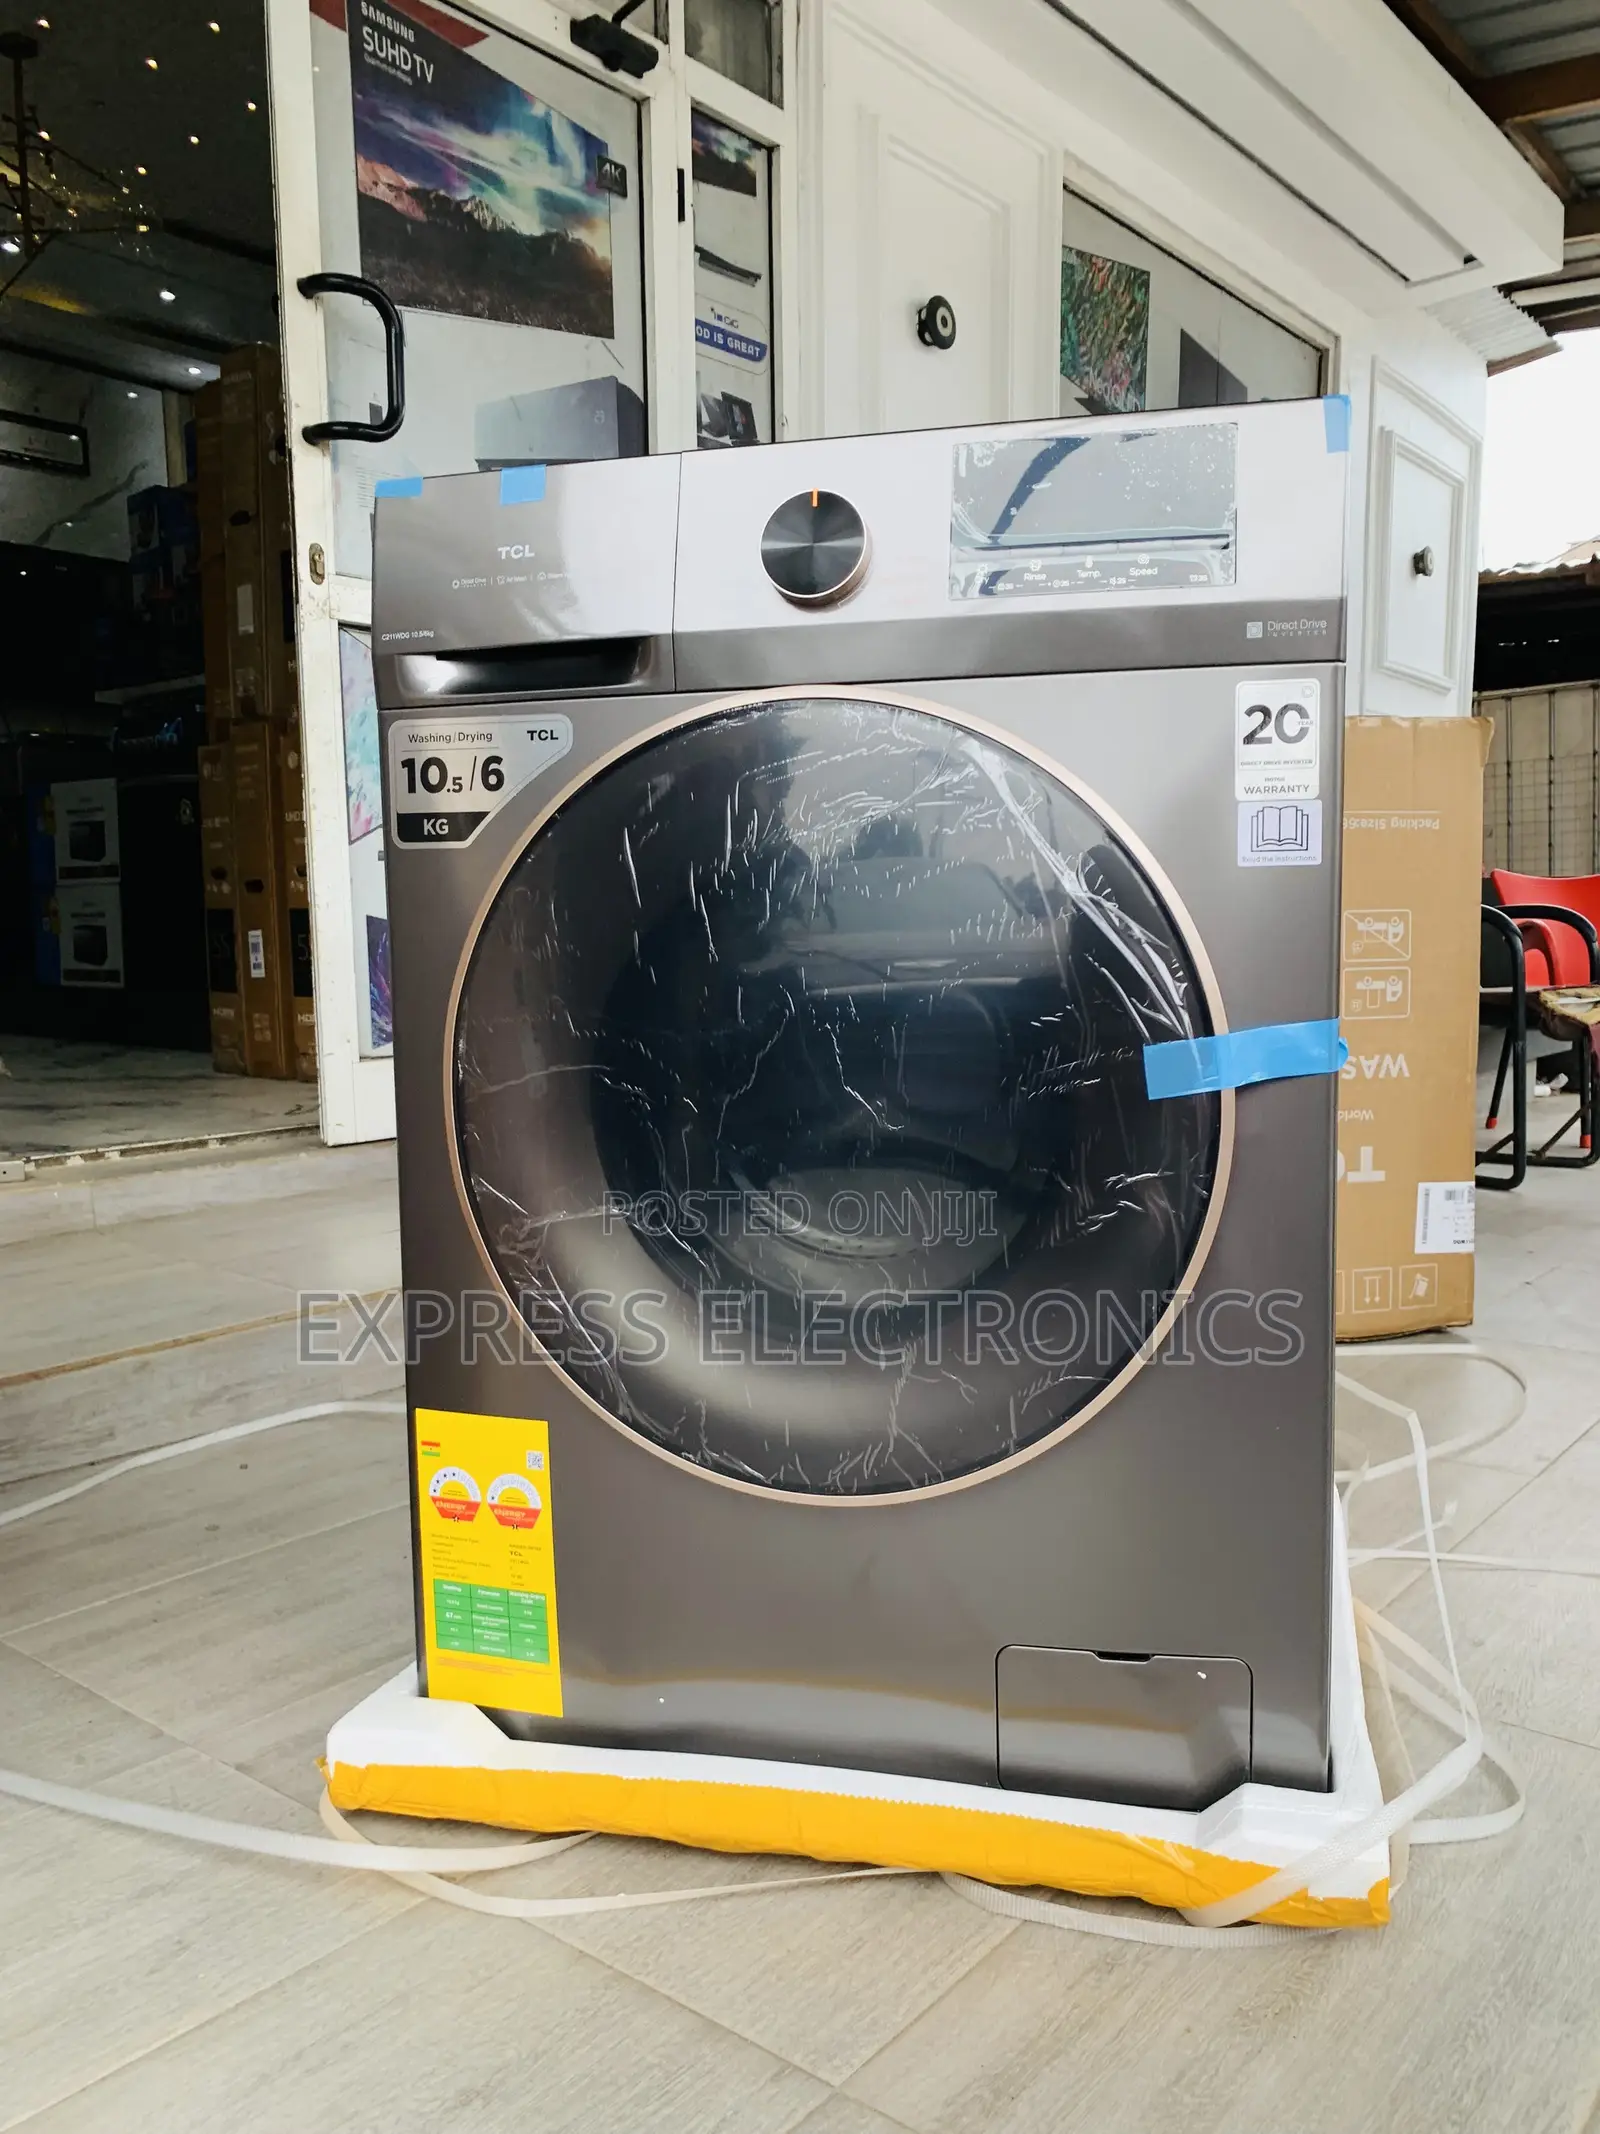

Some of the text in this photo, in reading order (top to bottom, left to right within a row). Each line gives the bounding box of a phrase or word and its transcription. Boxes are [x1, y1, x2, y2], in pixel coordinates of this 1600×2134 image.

[361, 1, 415, 43] SAMSUNG
[602, 162, 622, 183] 4K
[696, 325, 761, 357] OD IS GREAT
[498, 544, 535, 560] TCL
[1024, 572, 1046, 581] Rinse
[1129, 566, 1158, 577] Speed
[1267, 618, 1327, 631] Direct Drive
[527, 729, 559, 741] TCL
[1244, 784, 1311, 795] WARRANTY
[423, 818, 449, 836] KG
[1390, 816, 1440, 831] Packing
